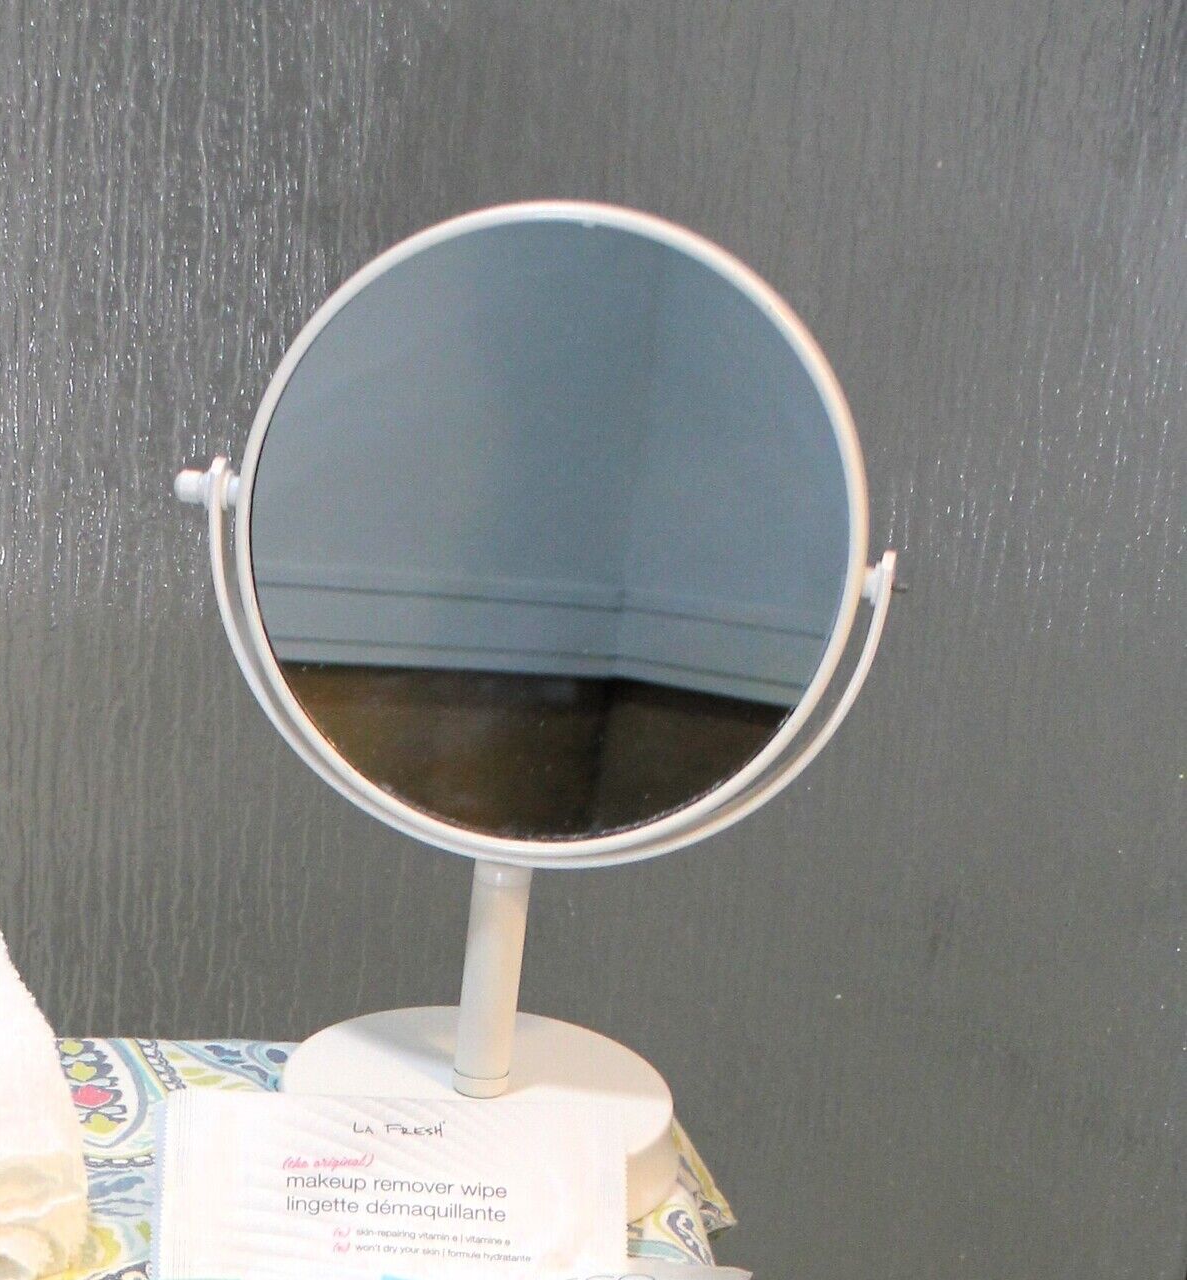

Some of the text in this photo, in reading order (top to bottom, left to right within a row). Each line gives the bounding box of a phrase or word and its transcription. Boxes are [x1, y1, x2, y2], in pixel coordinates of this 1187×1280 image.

[353, 1122, 445, 1137] LA FRESH
[286, 1173, 508, 1200] makeup remover wipe
[286, 1196, 506, 1222] lingette démaquillante
[356, 1228, 416, 1240] skin-repairing
[418, 1232, 450, 1242] vitamin
[466, 1236, 502, 1246] vitamine
[356, 1244, 381, 1252] won't
[383, 1244, 397, 1254] dry
[400, 1246, 420, 1256] your
[422, 1248, 440, 1256] skin
[448, 1249, 481, 1259] formule
[483, 1252, 532, 1263] hydratante
